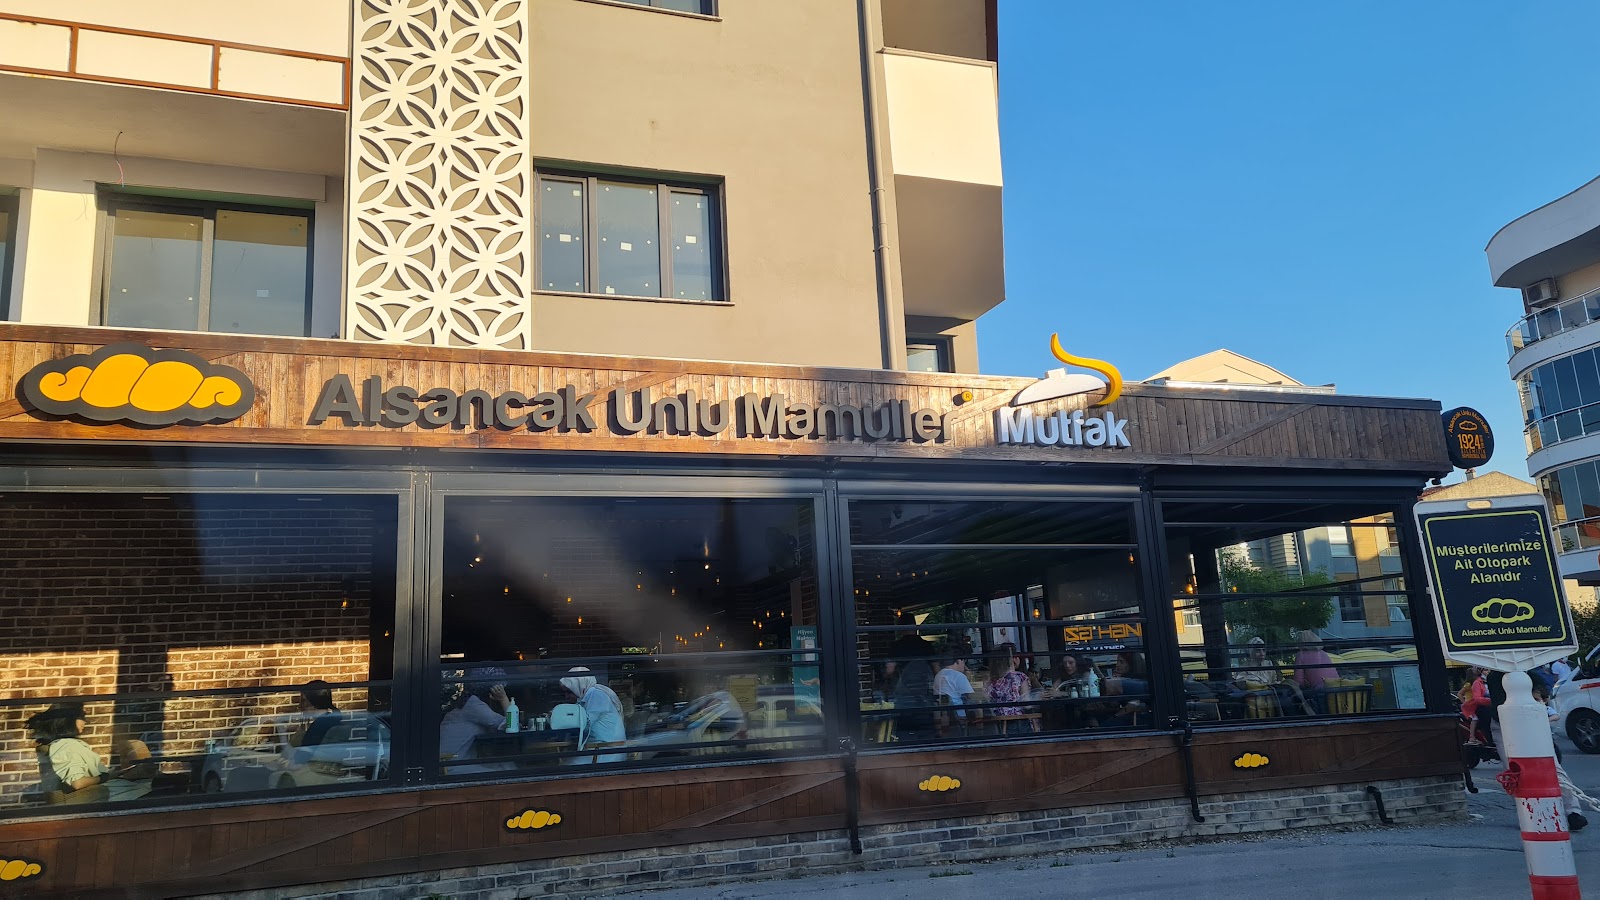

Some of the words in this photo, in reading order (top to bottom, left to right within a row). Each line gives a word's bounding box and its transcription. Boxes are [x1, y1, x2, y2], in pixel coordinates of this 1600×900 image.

[313, 373, 598, 430] Alsancak
[613, 386, 729, 433] Unlu
[744, 392, 960, 441] Mamuller
[998, 406, 1132, 448] Mutfak
[1457, 433, 1481, 450] 1924
[1436, 540, 1541, 557] Müşterilerimize
[1454, 558, 1473, 571] Ait
[1476, 555, 1531, 570] Otopark
[1470, 571, 1521, 584] Alanıdır
[1462, 627, 1497, 637] Alsancak
[1498, 626, 1515, 635] Unlu
[1516, 624, 1551, 634] Mamuller
